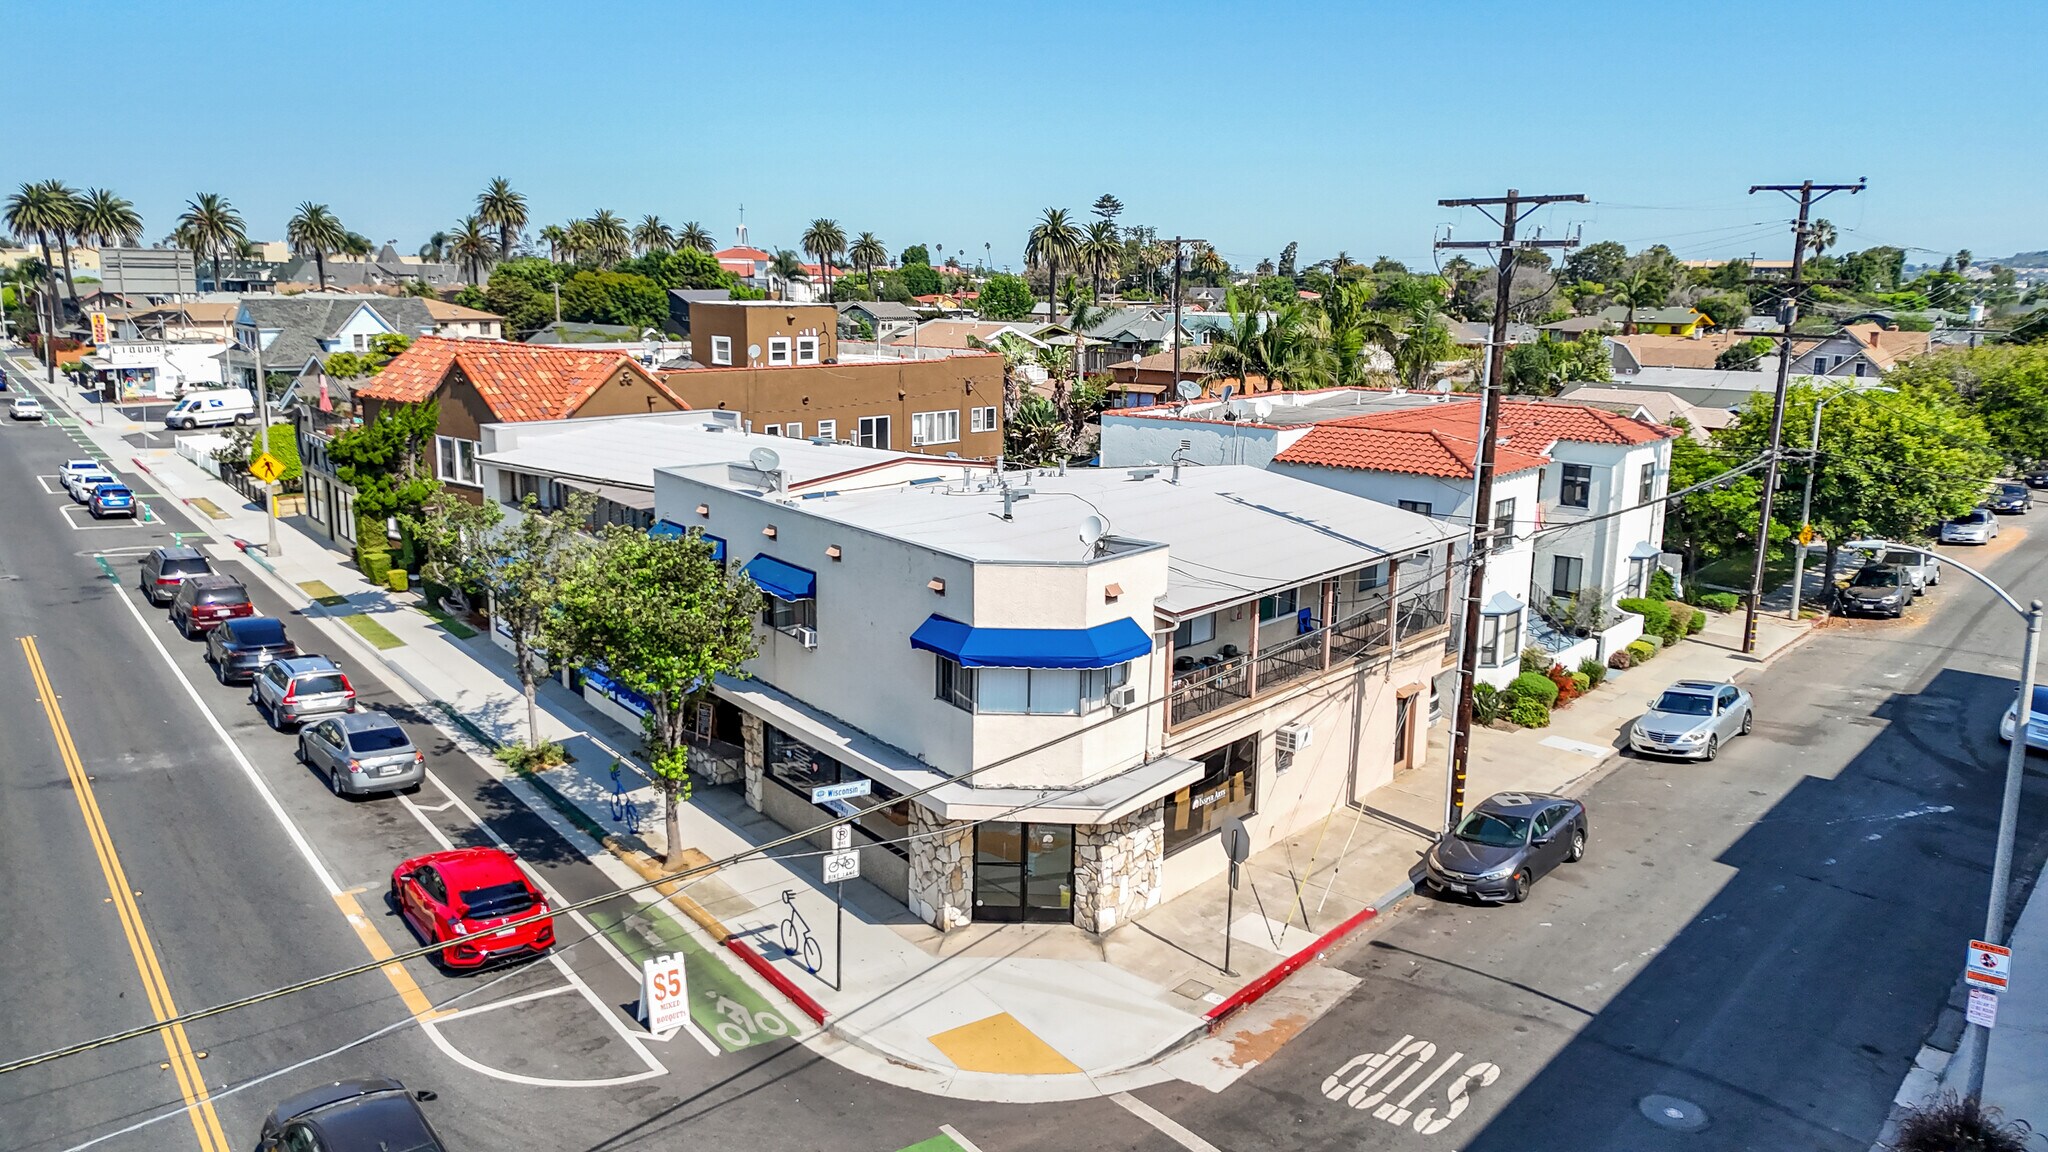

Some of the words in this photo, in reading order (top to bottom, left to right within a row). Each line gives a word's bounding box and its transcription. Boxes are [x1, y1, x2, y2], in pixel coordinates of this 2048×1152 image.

[112, 345, 161, 354] LIQUOR
[827, 786, 859, 797] Wisconsin
[1972, 942, 2009, 954] WARNING
[654, 969, 681, 1001] $5
[660, 1000, 680, 1010] MIXED
[1321, 1034, 1501, 1134] STOP
